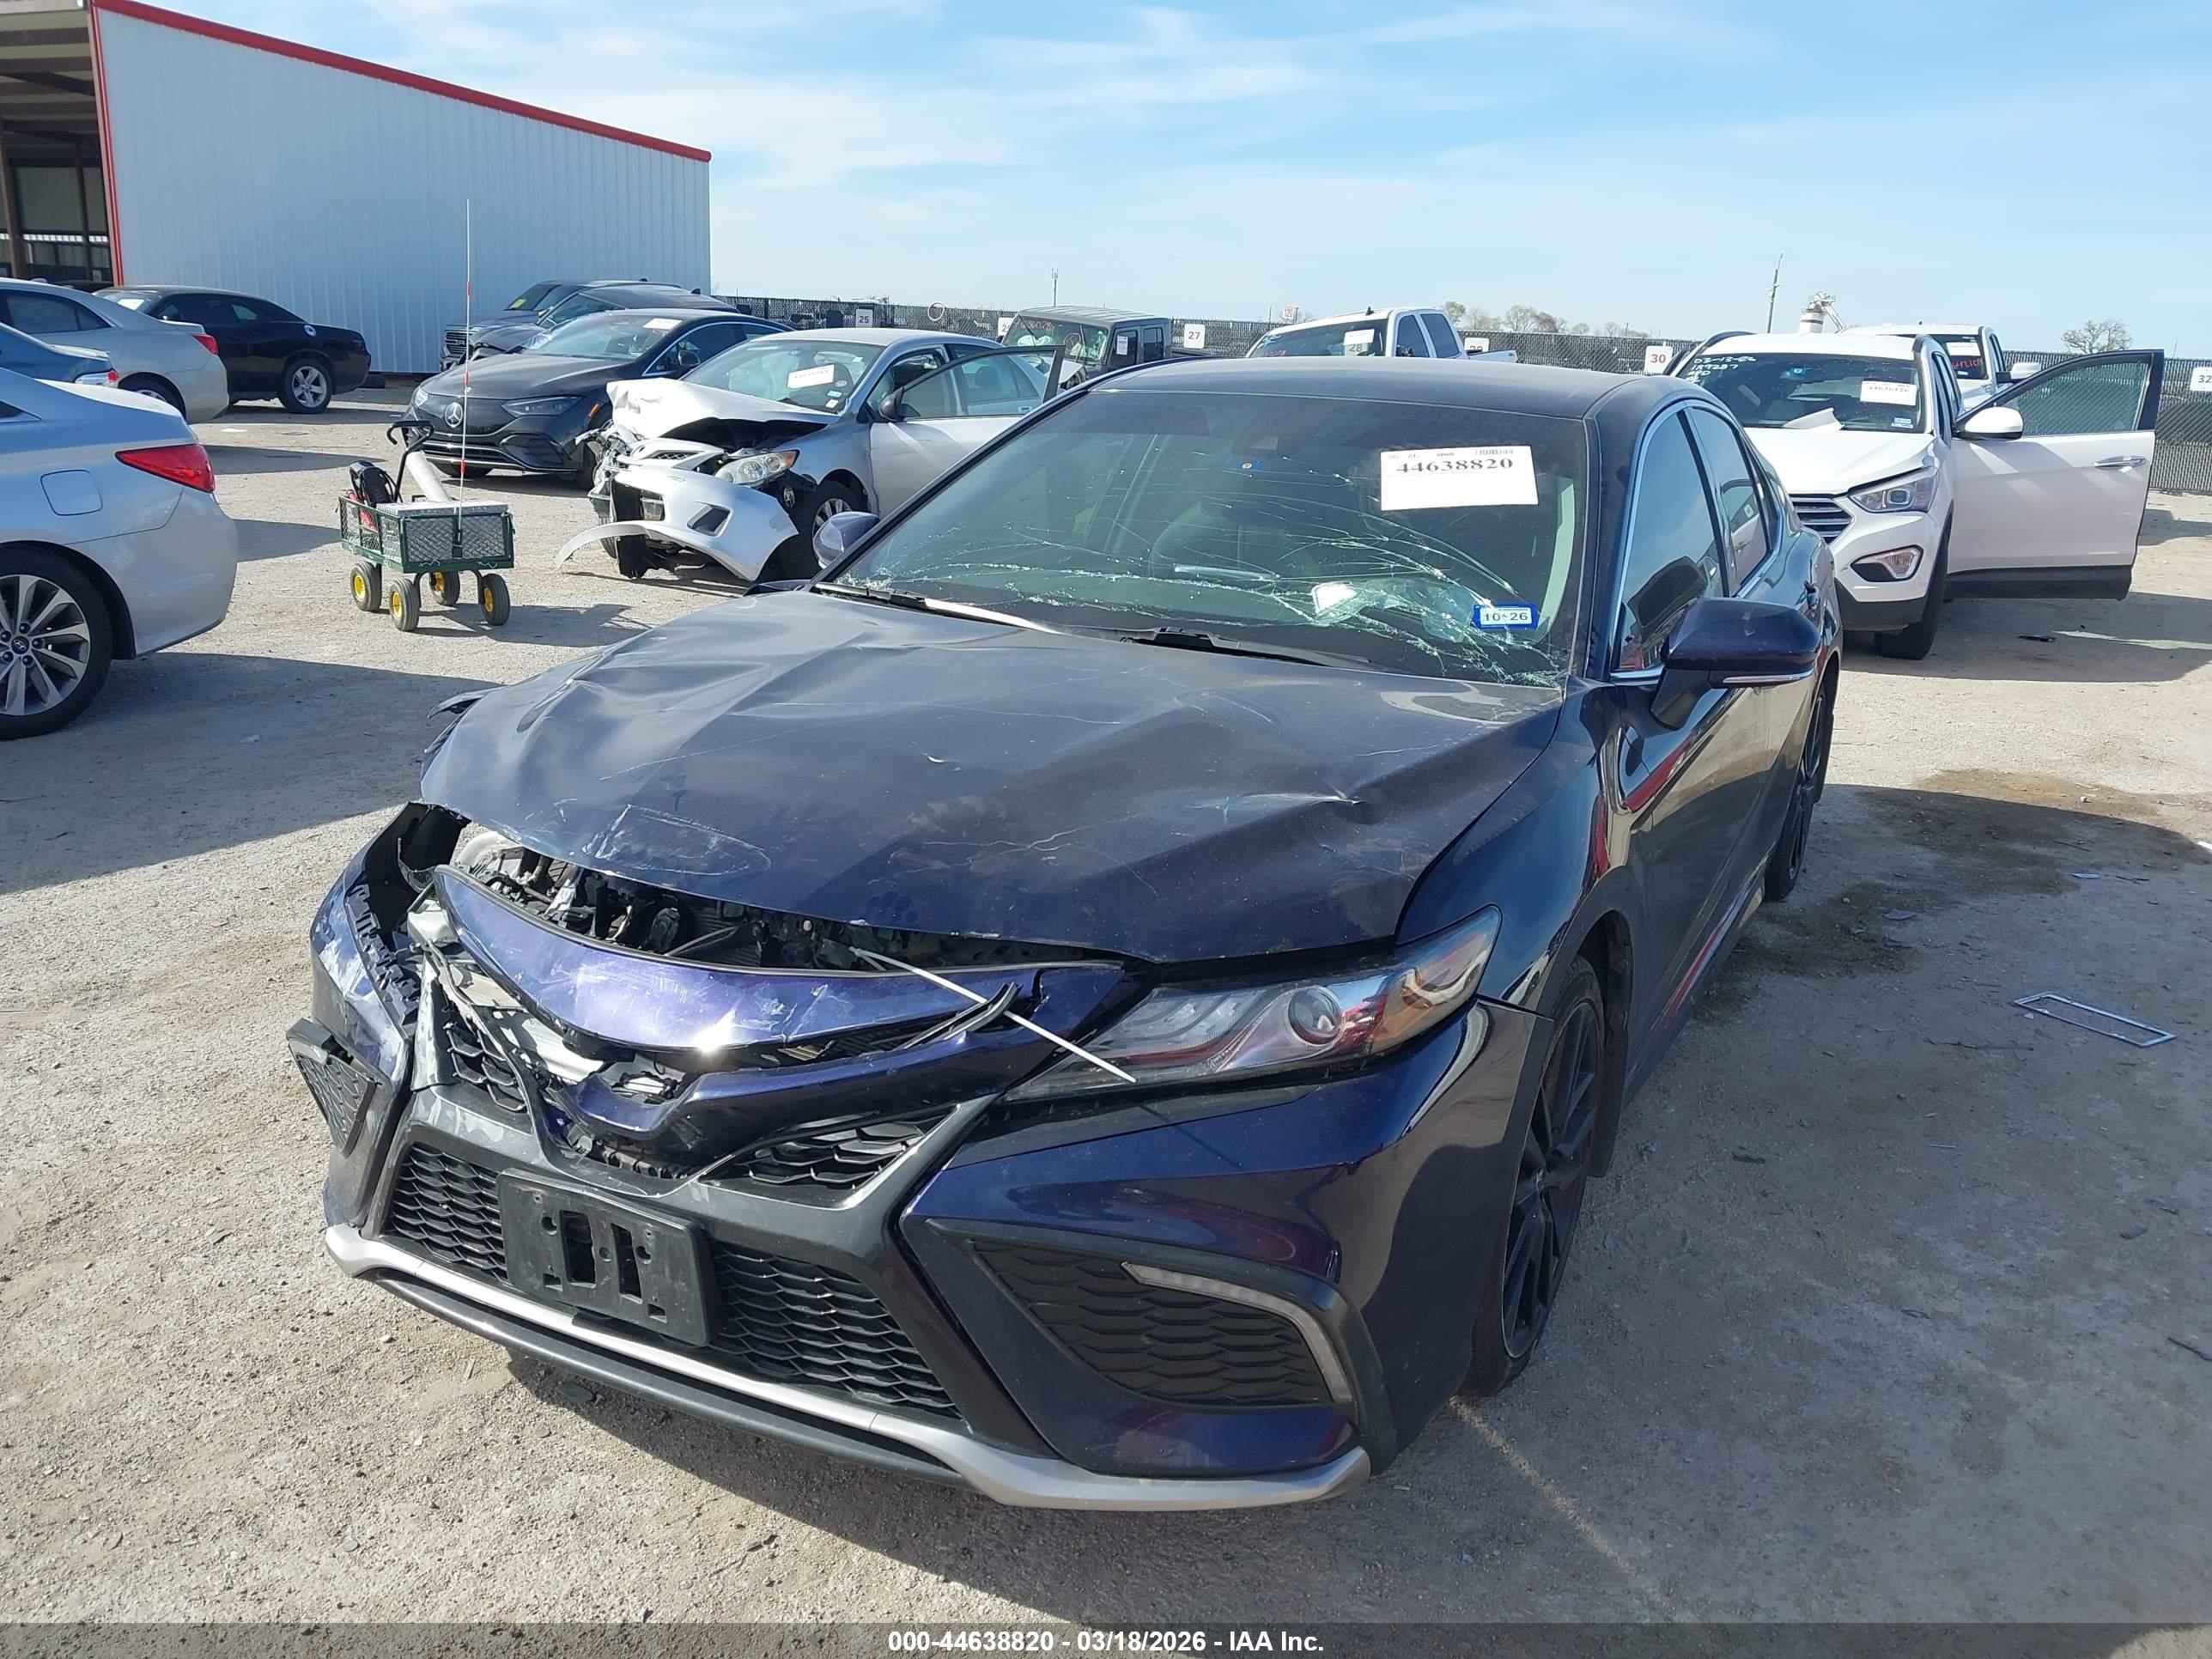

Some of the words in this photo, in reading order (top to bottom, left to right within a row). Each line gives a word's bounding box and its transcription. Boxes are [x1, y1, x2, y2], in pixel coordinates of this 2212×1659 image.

[858, 315, 870, 324] 25
[1188, 331, 1200, 340] 27
[1348, 343, 1363, 352] 28
[1650, 353, 1666, 363] 30
[2197, 374, 2212, 384] 32
[1396, 458, 1514, 473] 44638820
